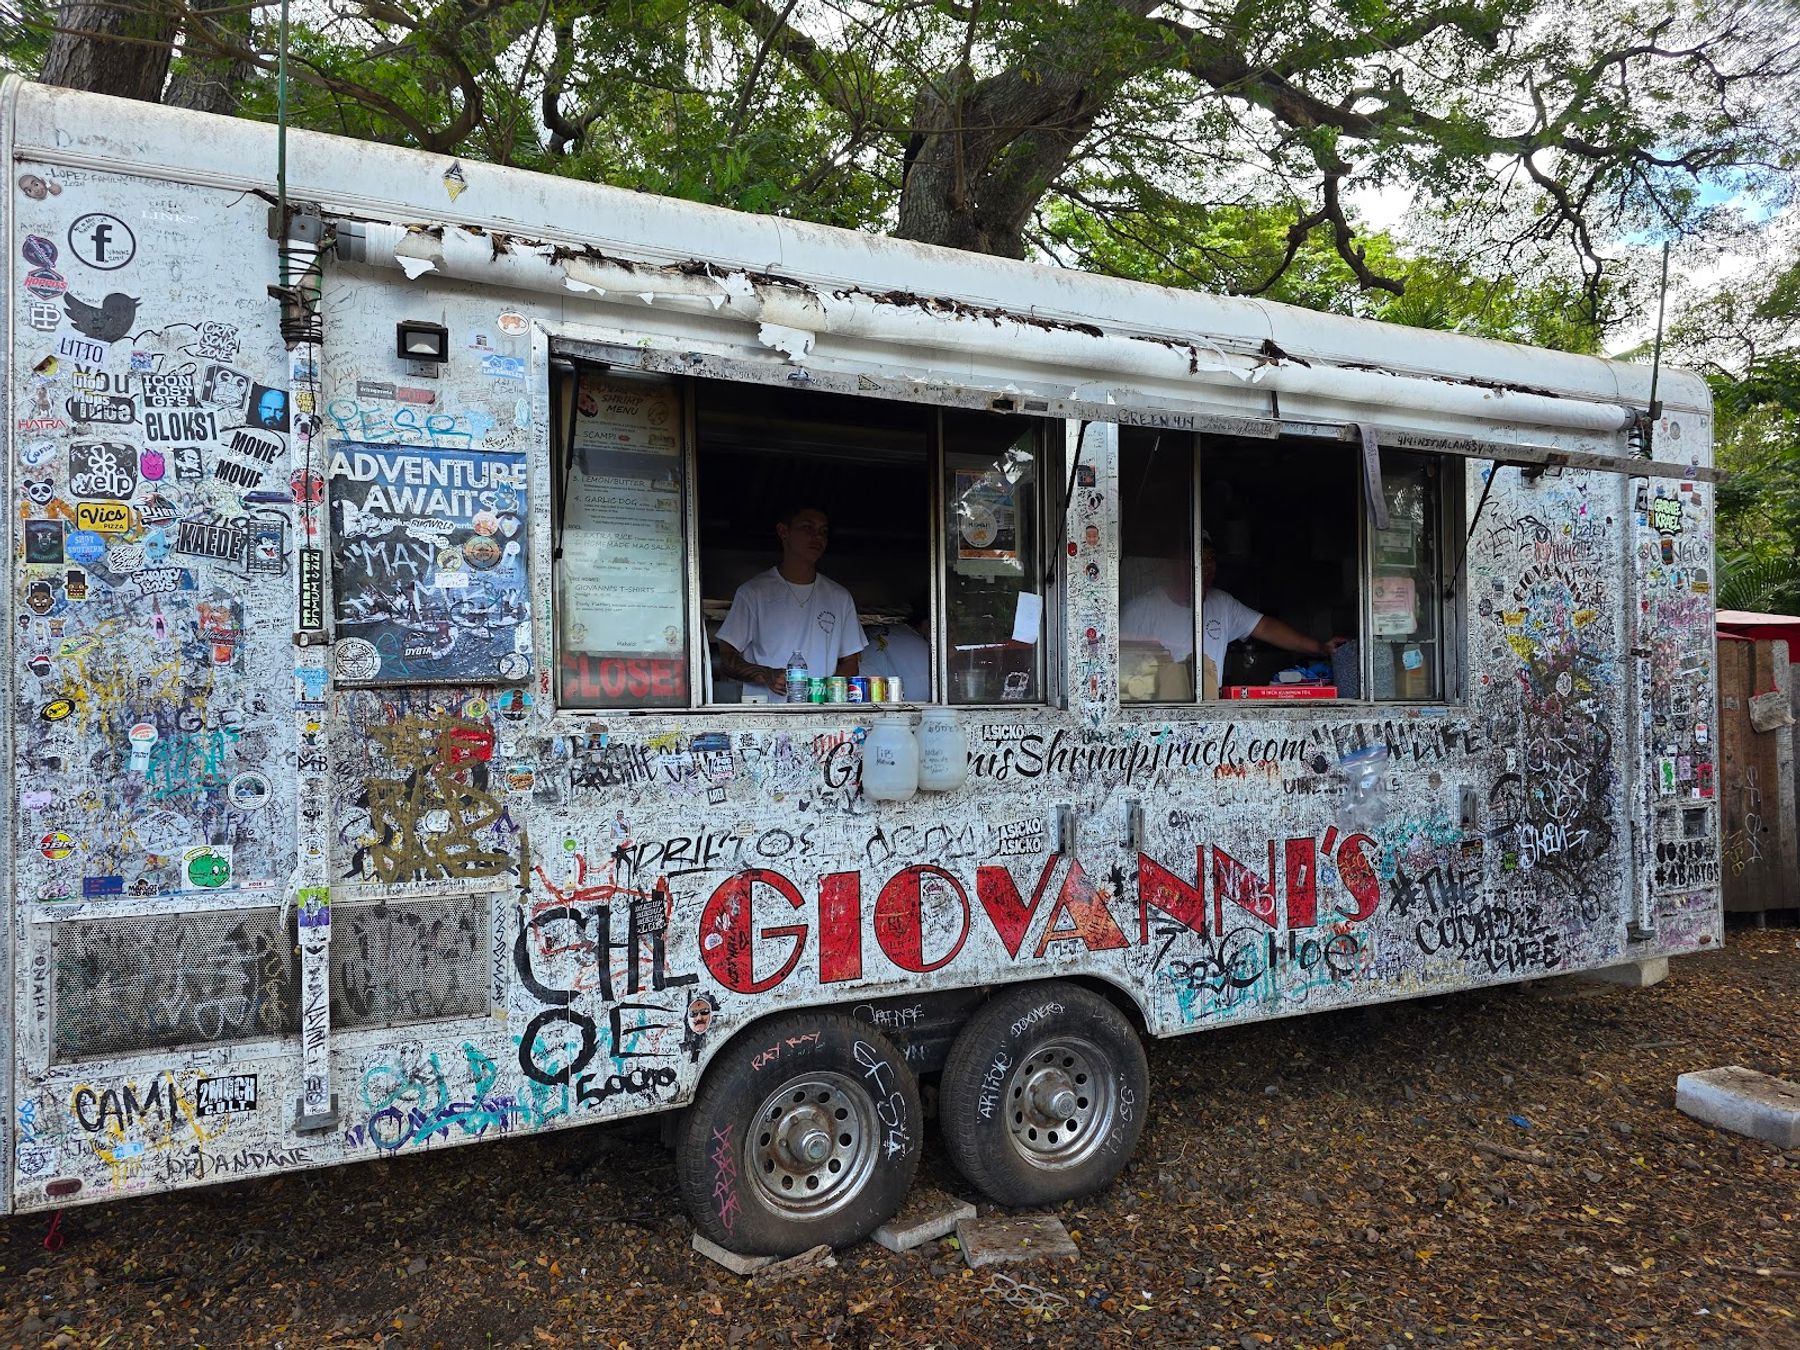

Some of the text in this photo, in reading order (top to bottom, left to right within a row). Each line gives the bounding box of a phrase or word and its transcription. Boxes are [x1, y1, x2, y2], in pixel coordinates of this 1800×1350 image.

[60, 337, 103, 363] LITTO
[144, 374, 192, 386] ICON
[145, 385, 194, 397] LOST
[601, 394, 644, 406] SHRIMP
[606, 405, 639, 416] MENU
[1117, 408, 1169, 426] GREEN
[230, 430, 279, 465] MOVIE
[328, 451, 527, 491] ADVENTURE
[76, 473, 133, 497] yelp
[361, 484, 500, 518] AWAITS
[619, 498, 637, 506] DOG
[80, 508, 127, 525] Vics
[178, 523, 242, 561] KAEDE
[563, 656, 686, 700] CLOSE
[823, 723, 1307, 789] GinisShrimpTruck.com
[999, 817, 1042, 840] ASICKO
[999, 837, 1042, 856] ASICKO
[698, 825, 1381, 995] GIOVANNI'S
[751, 1031, 822, 1072] RAY RAY
[199, 1076, 256, 1106] 2MUCH
